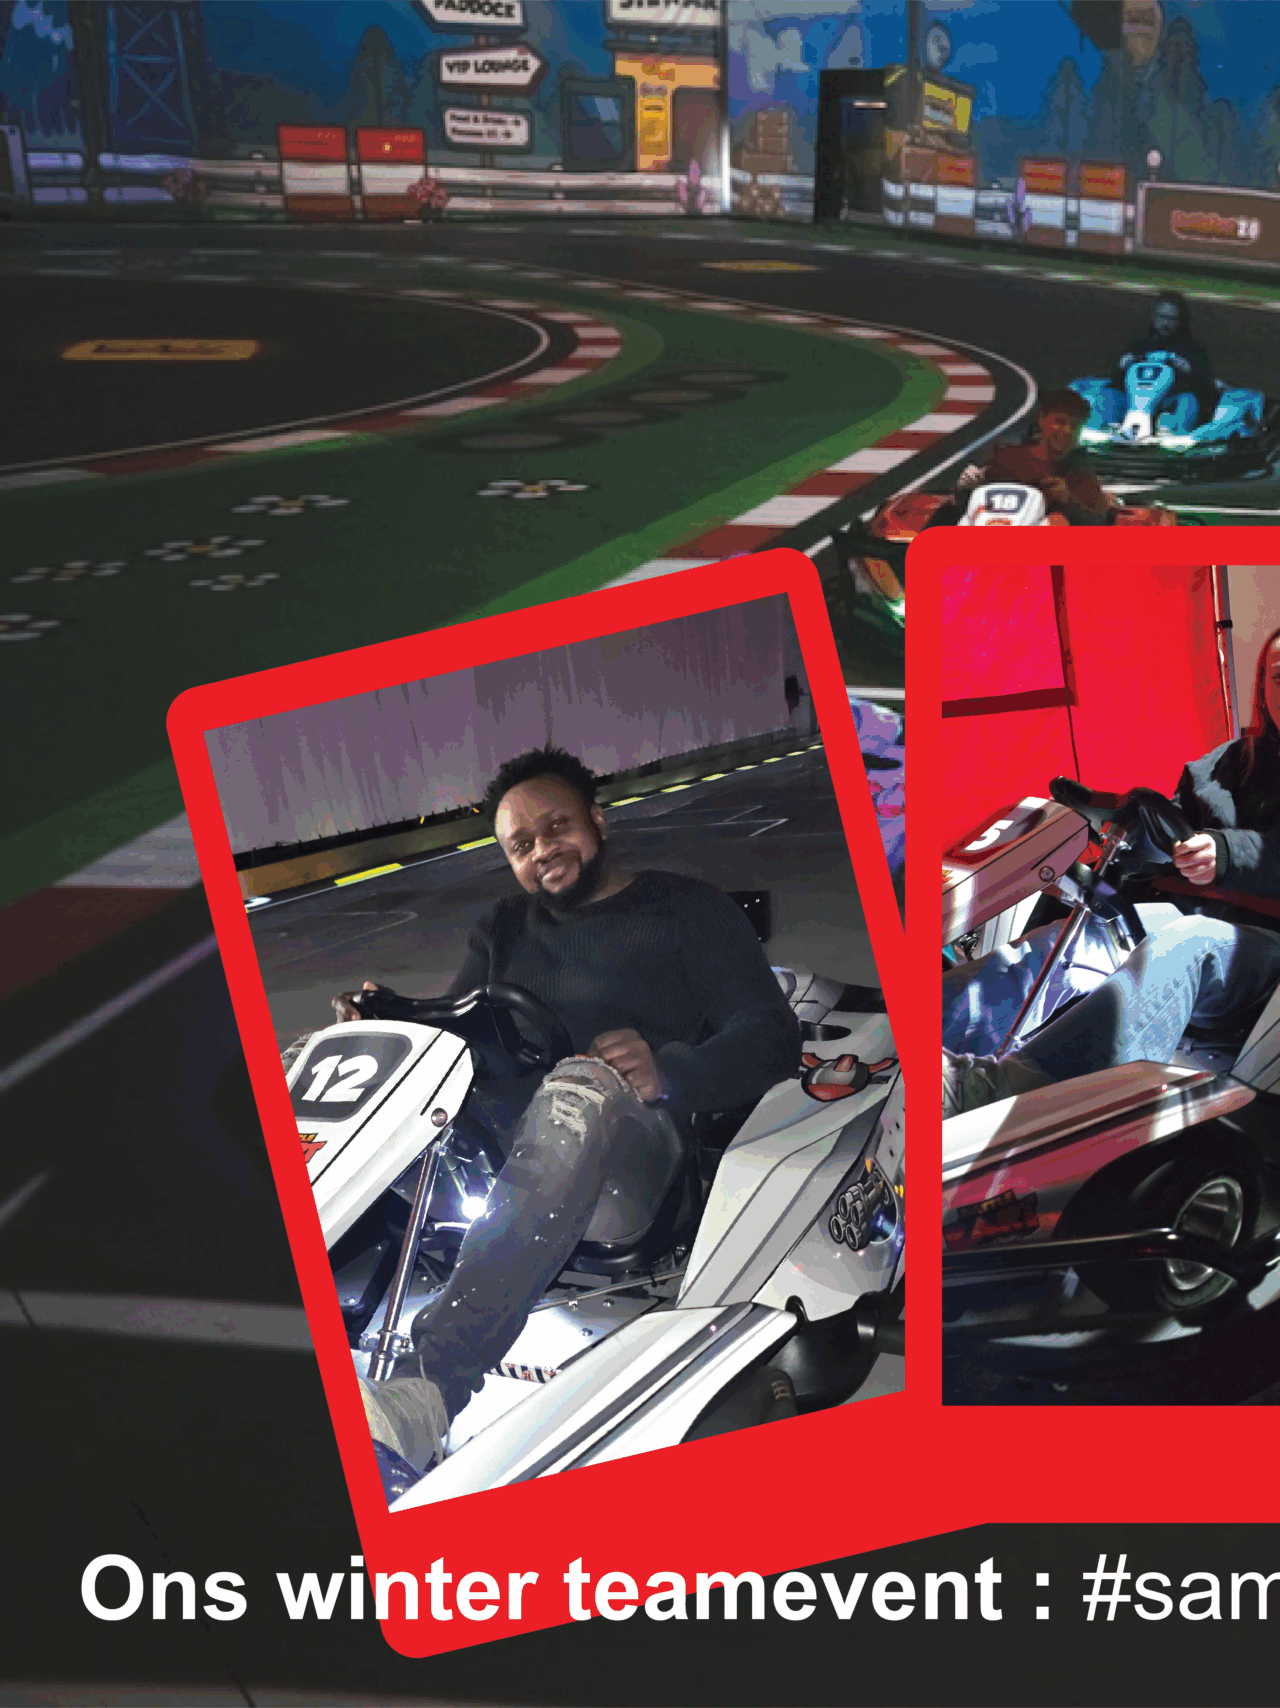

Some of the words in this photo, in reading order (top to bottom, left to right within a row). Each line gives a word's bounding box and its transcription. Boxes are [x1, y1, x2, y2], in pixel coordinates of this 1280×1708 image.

[445, 59, 471, 75] VIP
[474, 57, 531, 75] LOUNGE
[964, 819, 1014, 851] 5
[301, 1054, 379, 1102] 12
